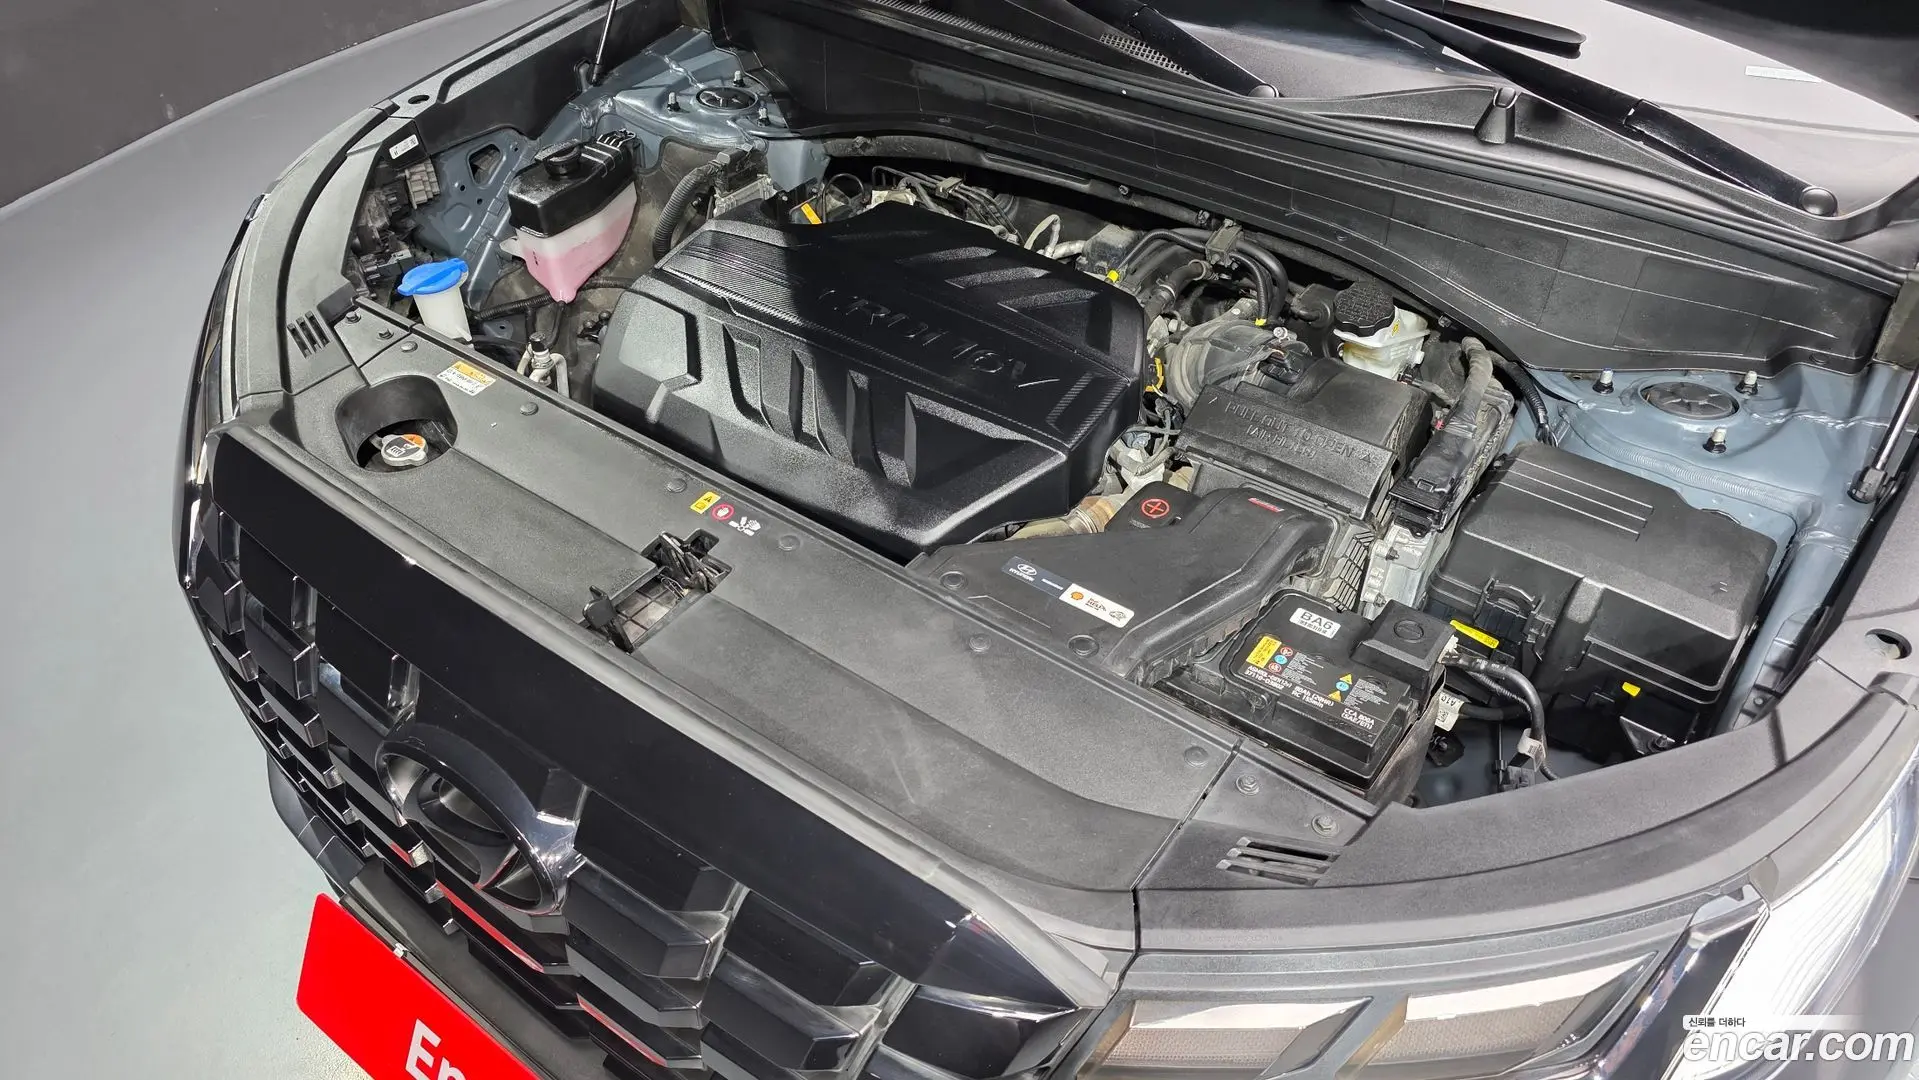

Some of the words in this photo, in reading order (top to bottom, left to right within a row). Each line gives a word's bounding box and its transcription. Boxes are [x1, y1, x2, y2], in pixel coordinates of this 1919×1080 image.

[1225, 401, 1260, 422] PULL
[1260, 413, 1291, 433] OUT
[1314, 434, 1356, 458] OPEN
[1300, 610, 1334, 630] BA6
[1343, 707, 1358, 718] CCA
